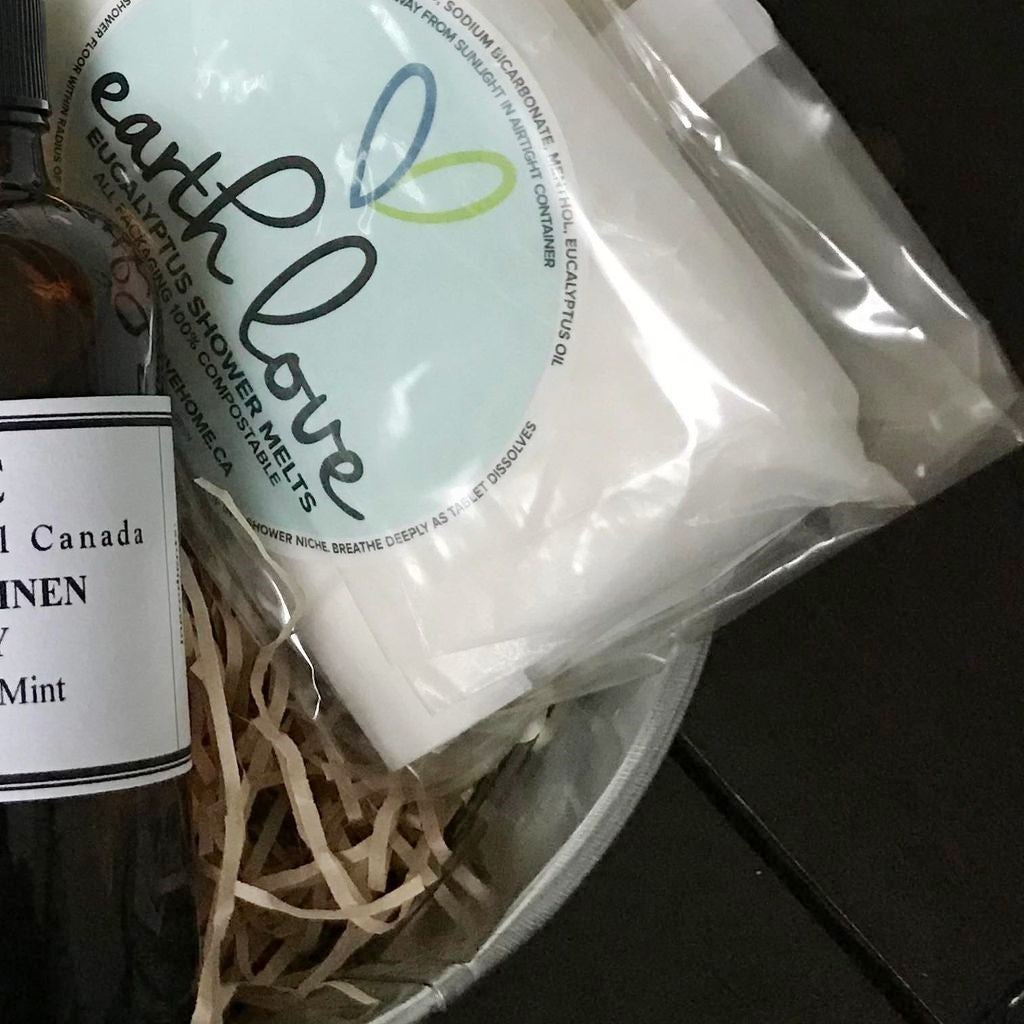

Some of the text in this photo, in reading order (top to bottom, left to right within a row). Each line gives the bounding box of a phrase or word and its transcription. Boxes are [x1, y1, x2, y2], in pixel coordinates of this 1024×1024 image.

[72, 36, 98, 75] FLOOR
[444, 0, 494, 49] SODIUM
[60, 76, 77, 116] WITHIN
[53, 118, 67, 162] RADIUS
[421, 9, 458, 43] FROM
[454, 39, 507, 99] SUNLIGHT
[500, 100, 516, 116] IN
[509, 118, 542, 180] AIRTIGHT
[534, 184, 555, 268] CONTAINER
[87, 127, 317, 513] EUCALYPTUS SHOWER MELTS
[91, 71, 377, 521] earth love
[558, 238, 578, 340] EUCALYPTUS
[93, 173, 115, 200] ALL
[170, 304, 200, 350] 100%
[197, 351, 282, 487] COMPOSTABLE
[551, 343, 566, 366] OIL
[332, 539, 383, 554] BREATHE
[385, 521, 430, 548] DEEPLY
[431, 513, 449, 529] AS
[448, 480, 489, 518] TABLET
[487, 420, 537, 485] DISSOLVES
[31, 519, 144, 552] Canada
